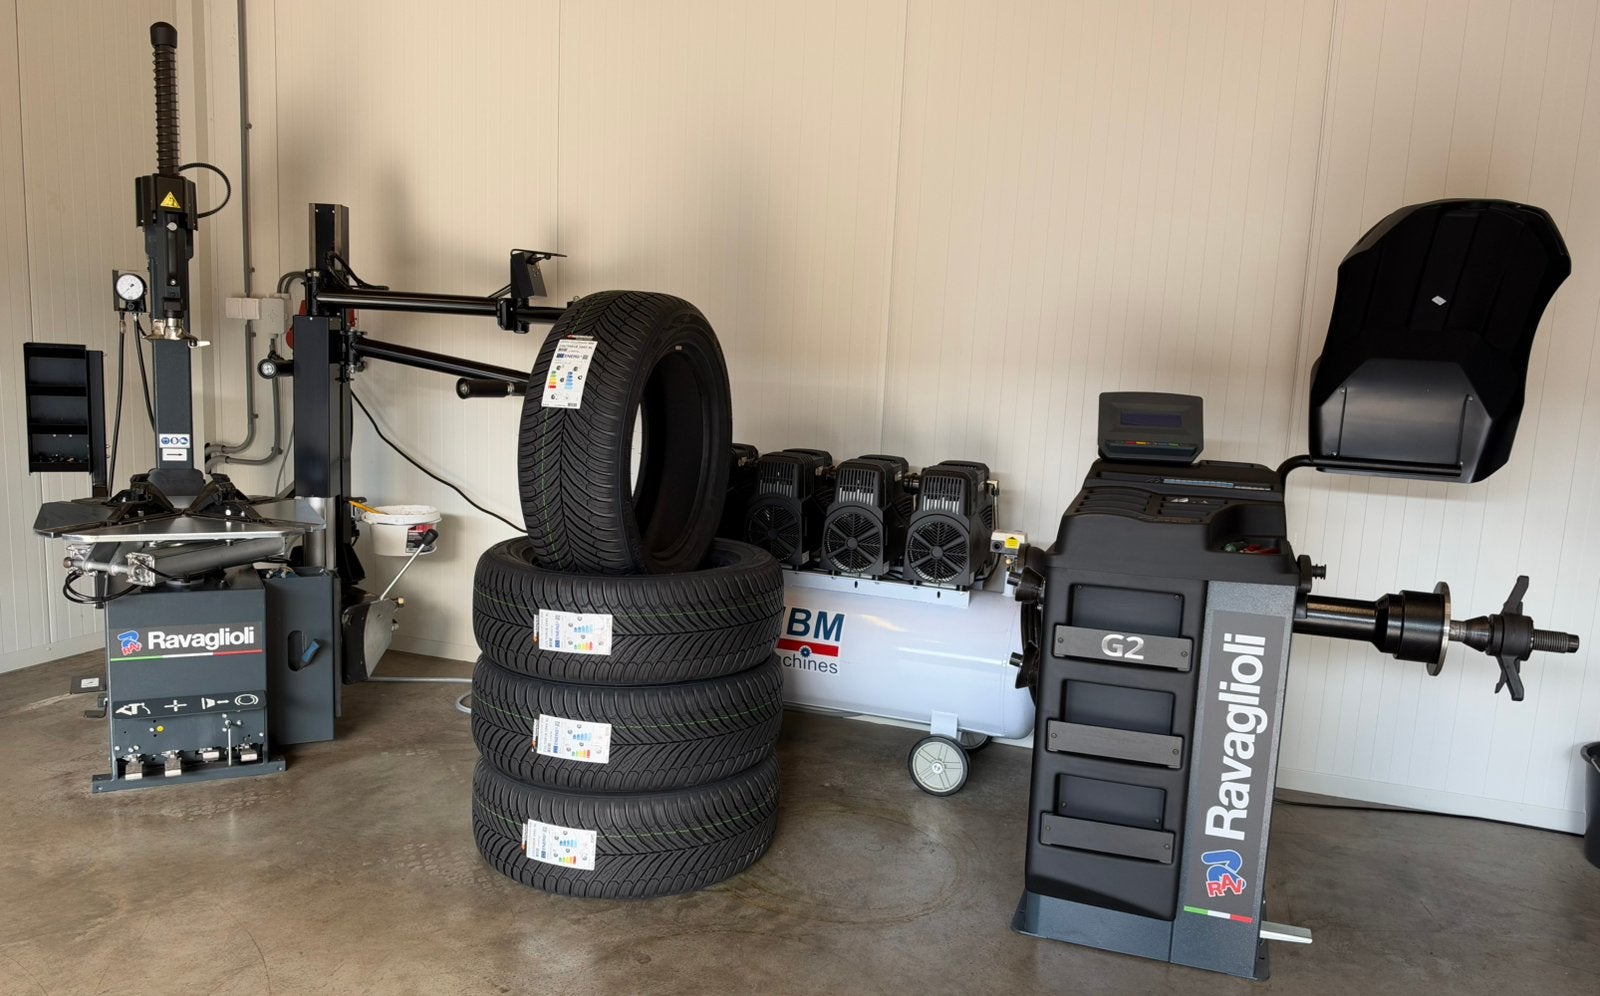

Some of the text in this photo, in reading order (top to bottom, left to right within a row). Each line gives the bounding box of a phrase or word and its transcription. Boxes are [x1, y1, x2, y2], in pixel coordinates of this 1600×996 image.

[781, 606, 845, 642] BM
[148, 626, 254, 651] Ravaglioli
[1101, 634, 1144, 660] G2
[780, 653, 838, 674] chines
[1205, 633, 1268, 841] Ravaglioli
[1206, 873, 1243, 897] RAV
